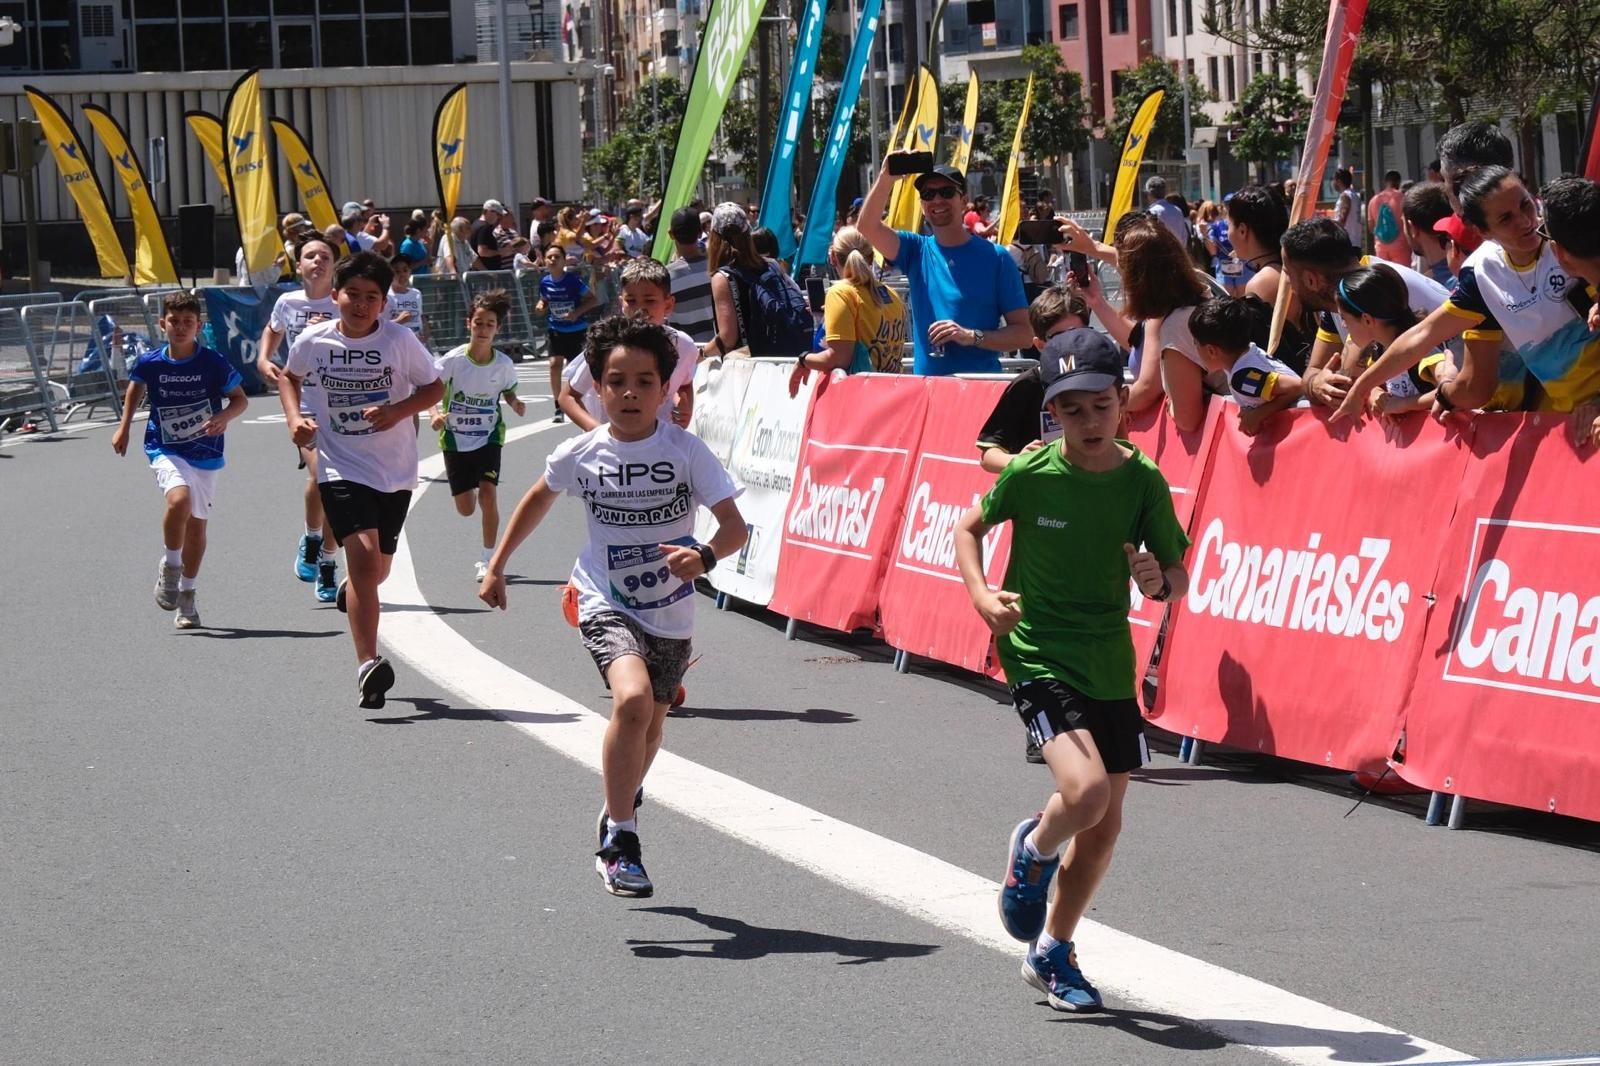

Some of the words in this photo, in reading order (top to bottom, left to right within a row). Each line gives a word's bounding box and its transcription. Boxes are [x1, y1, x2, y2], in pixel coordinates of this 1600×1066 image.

[330, 349, 382, 365] HPS
[1058, 353, 1077, 375] M
[324, 377, 363, 389] JUNIOR
[171, 414, 204, 432] 9058
[456, 417, 483, 426] 9183
[598, 461, 676, 487] HPS
[601, 489, 626, 499] CARRERA
[627, 489, 634, 498] DE
[635, 488, 646, 498] LAS
[595, 507, 649, 523] JUNIOR
[652, 499, 688, 520] RACE
[1037, 516, 1068, 529] Binter
[610, 547, 643, 561] HPS
